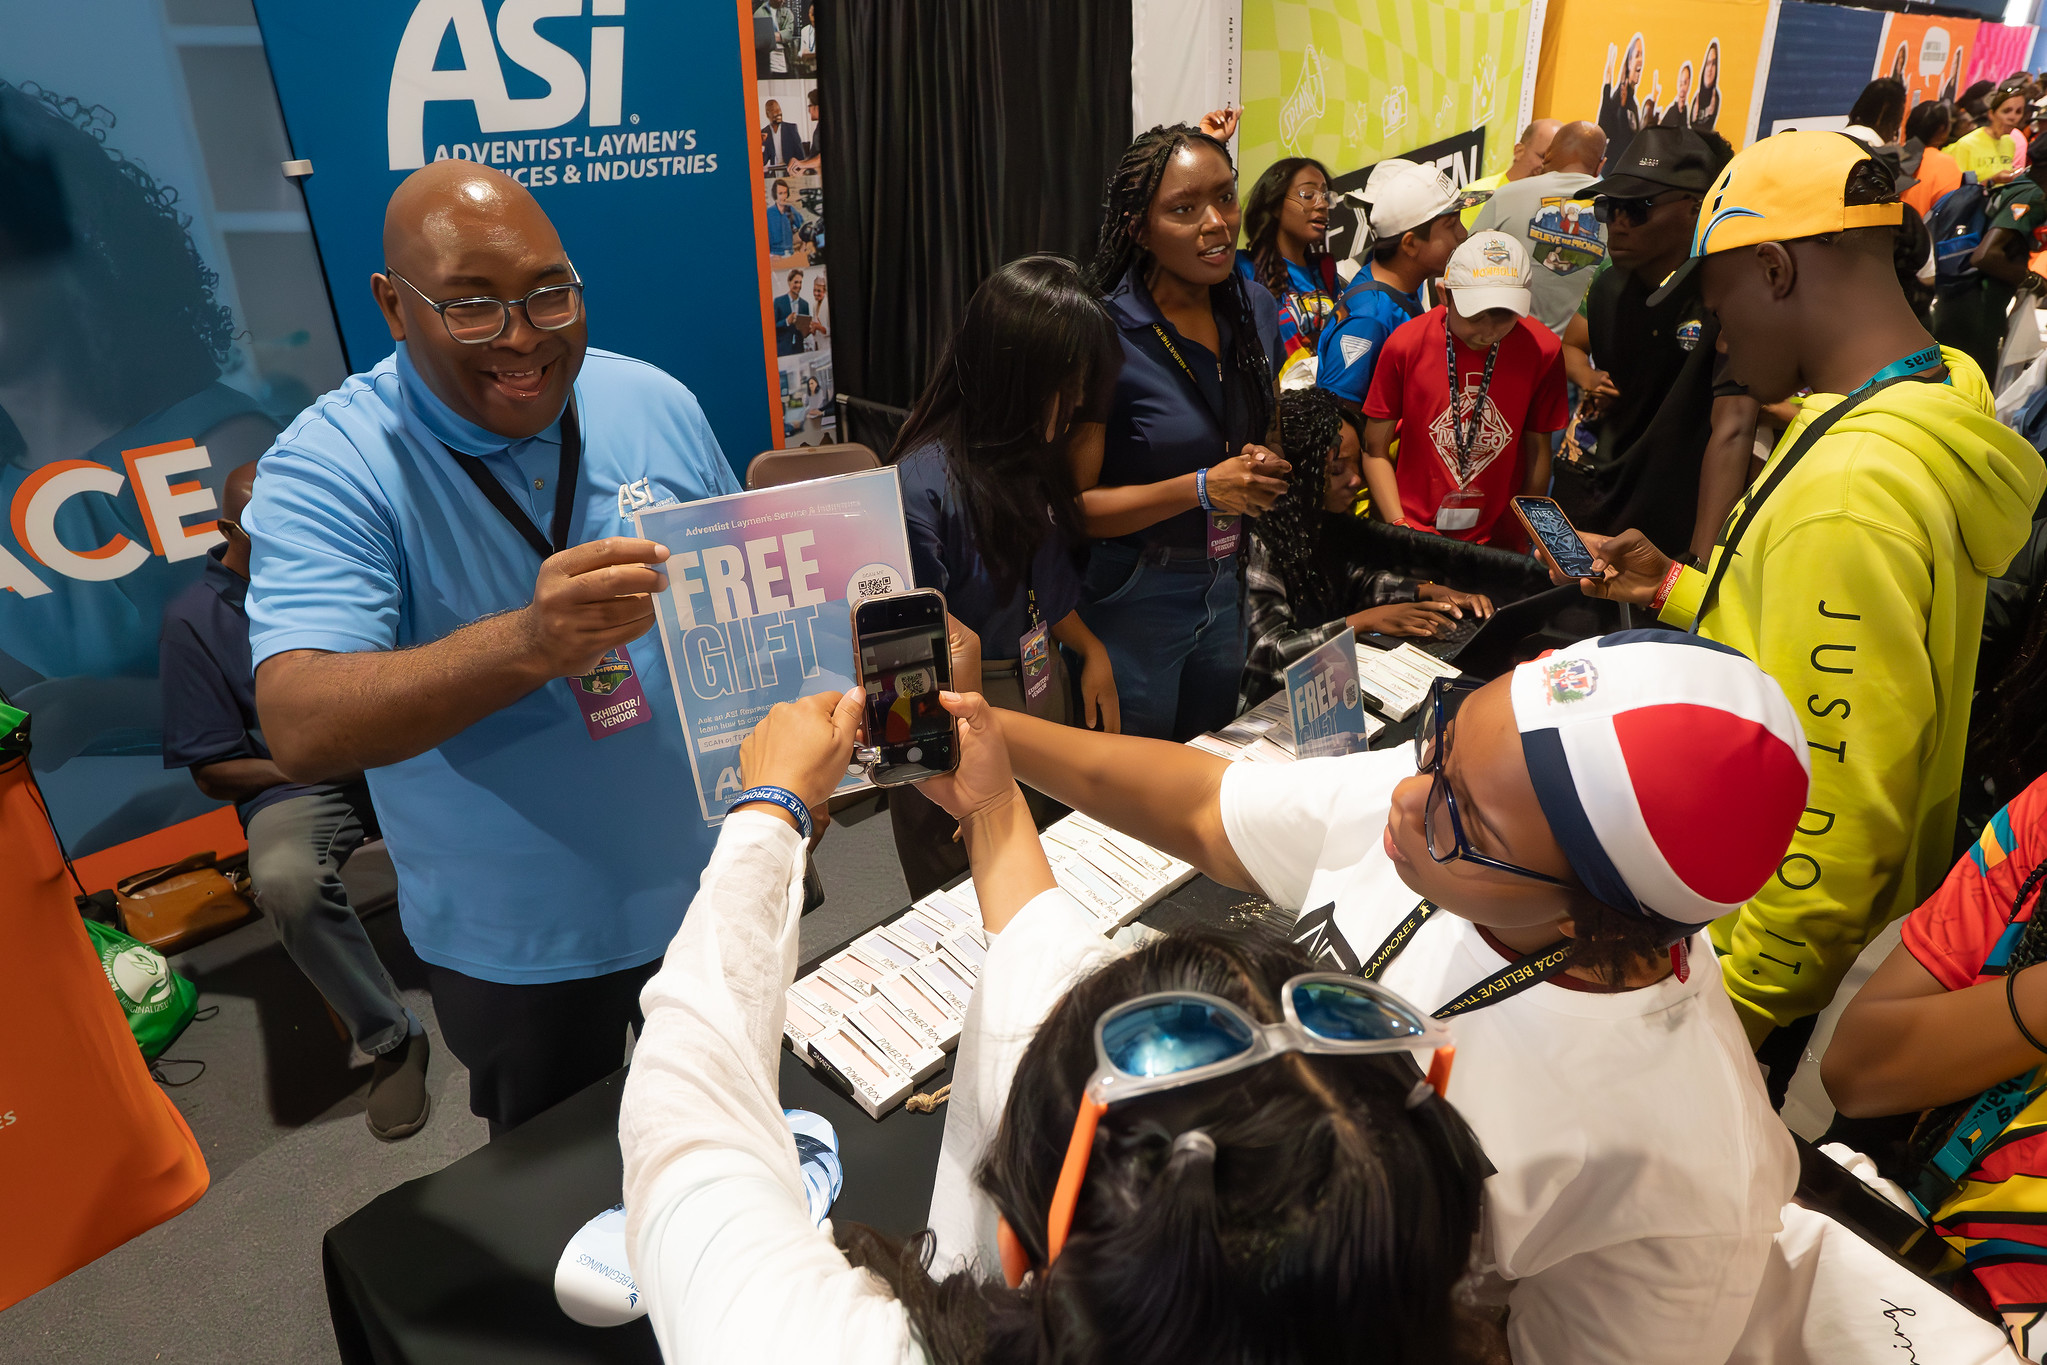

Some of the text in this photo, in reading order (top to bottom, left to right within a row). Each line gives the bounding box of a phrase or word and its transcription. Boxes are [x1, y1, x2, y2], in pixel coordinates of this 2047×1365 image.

[433, 129, 697, 164] ADVENTIST-LAYMEN'S
[562, 164, 581, 184] &
[587, 153, 718, 182] INDUSTRIES
[1473, 266, 1518, 278] MONGOLIA
[685, 521, 730, 537] Adventist
[666, 529, 826, 631] FREE
[681, 603, 822, 701] GIFT
[1294, 666, 1339, 731] FREE
[1807, 599, 1861, 764] JUST
[590, 696, 640, 723] EXHIBITOR/
[601, 708, 638, 728] VENDOR
[703, 738, 724, 748] SCAN
[771, 792, 788, 804] THE
[1777, 806, 1836, 890] DO
[1364, 918, 1416, 979] CAMPOREE
[1477, 965, 1535, 999] BELIEVE
[1450, 994, 1481, 1012] THE
[904, 1008, 942, 1043] POWER BOX
[876, 1038, 916, 1073] POWER BOX
[842, 1066, 883, 1103] POWER BOX
[576, 1253, 631, 1286] BEGINNINGS
